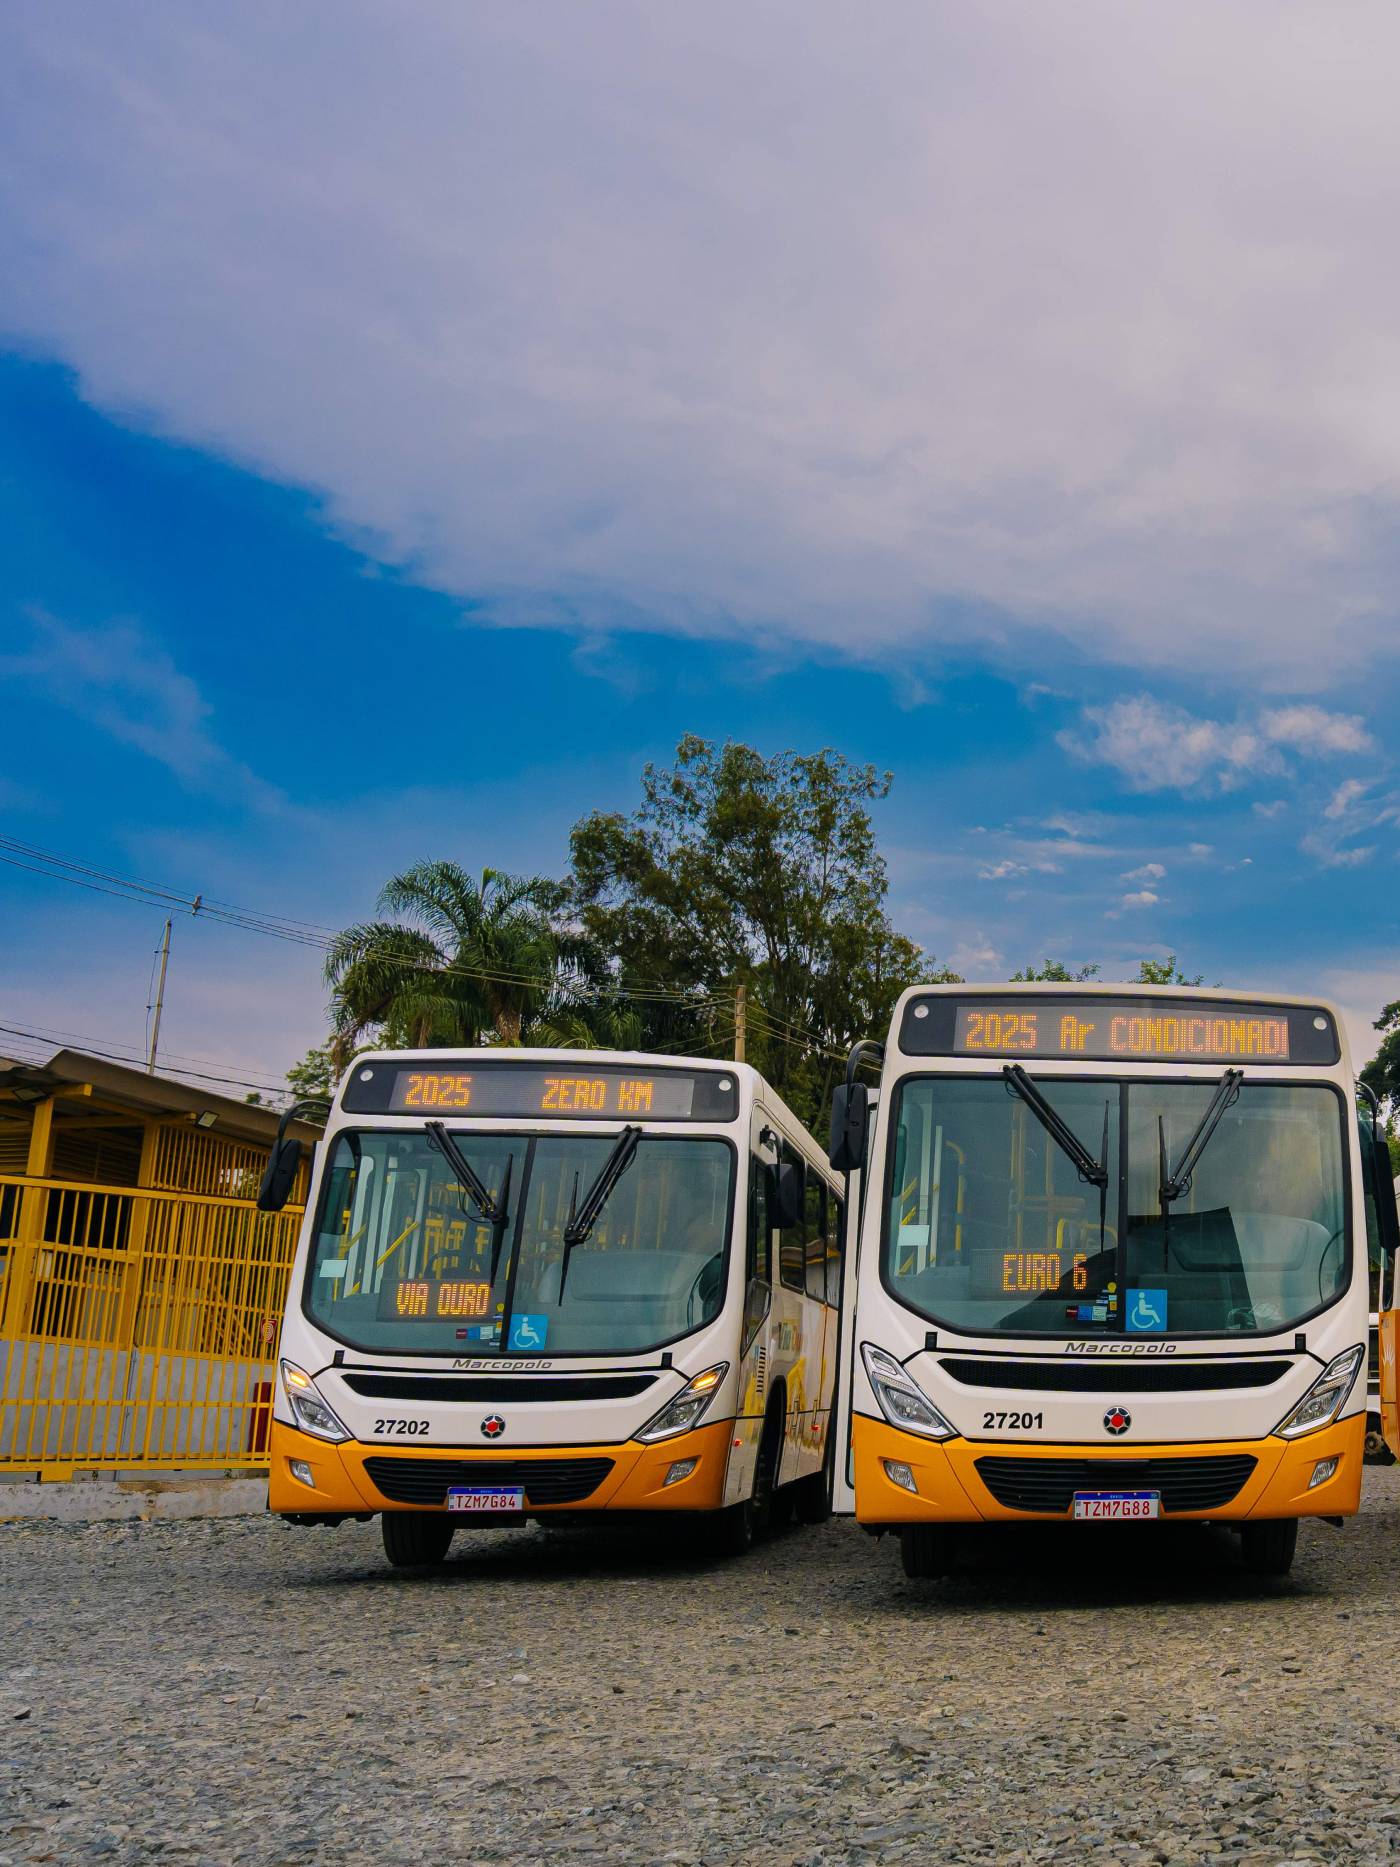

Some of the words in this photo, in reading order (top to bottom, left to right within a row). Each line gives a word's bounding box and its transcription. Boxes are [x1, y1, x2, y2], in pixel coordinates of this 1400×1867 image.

[965, 1013, 1037, 1049] 2025
[1060, 1015, 1095, 1050] Ar
[405, 1075, 473, 1107] 2025
[541, 1079, 607, 1110] ZERO
[616, 1081, 654, 1111] KM
[1003, 1254, 1060, 1291] EURO
[1073, 1254, 1087, 1290] 6
[396, 1283, 429, 1315] VIA
[437, 1283, 490, 1316] OURO
[1064, 1342, 1177, 1355] Marcopolo
[451, 1359, 553, 1371] Marcopolo
[373, 1419, 430, 1435] 27202
[982, 1412, 1043, 1430] 27201
[456, 1495, 516, 1509] TZM7G84
[1082, 1500, 1150, 1517] TZM7G88
